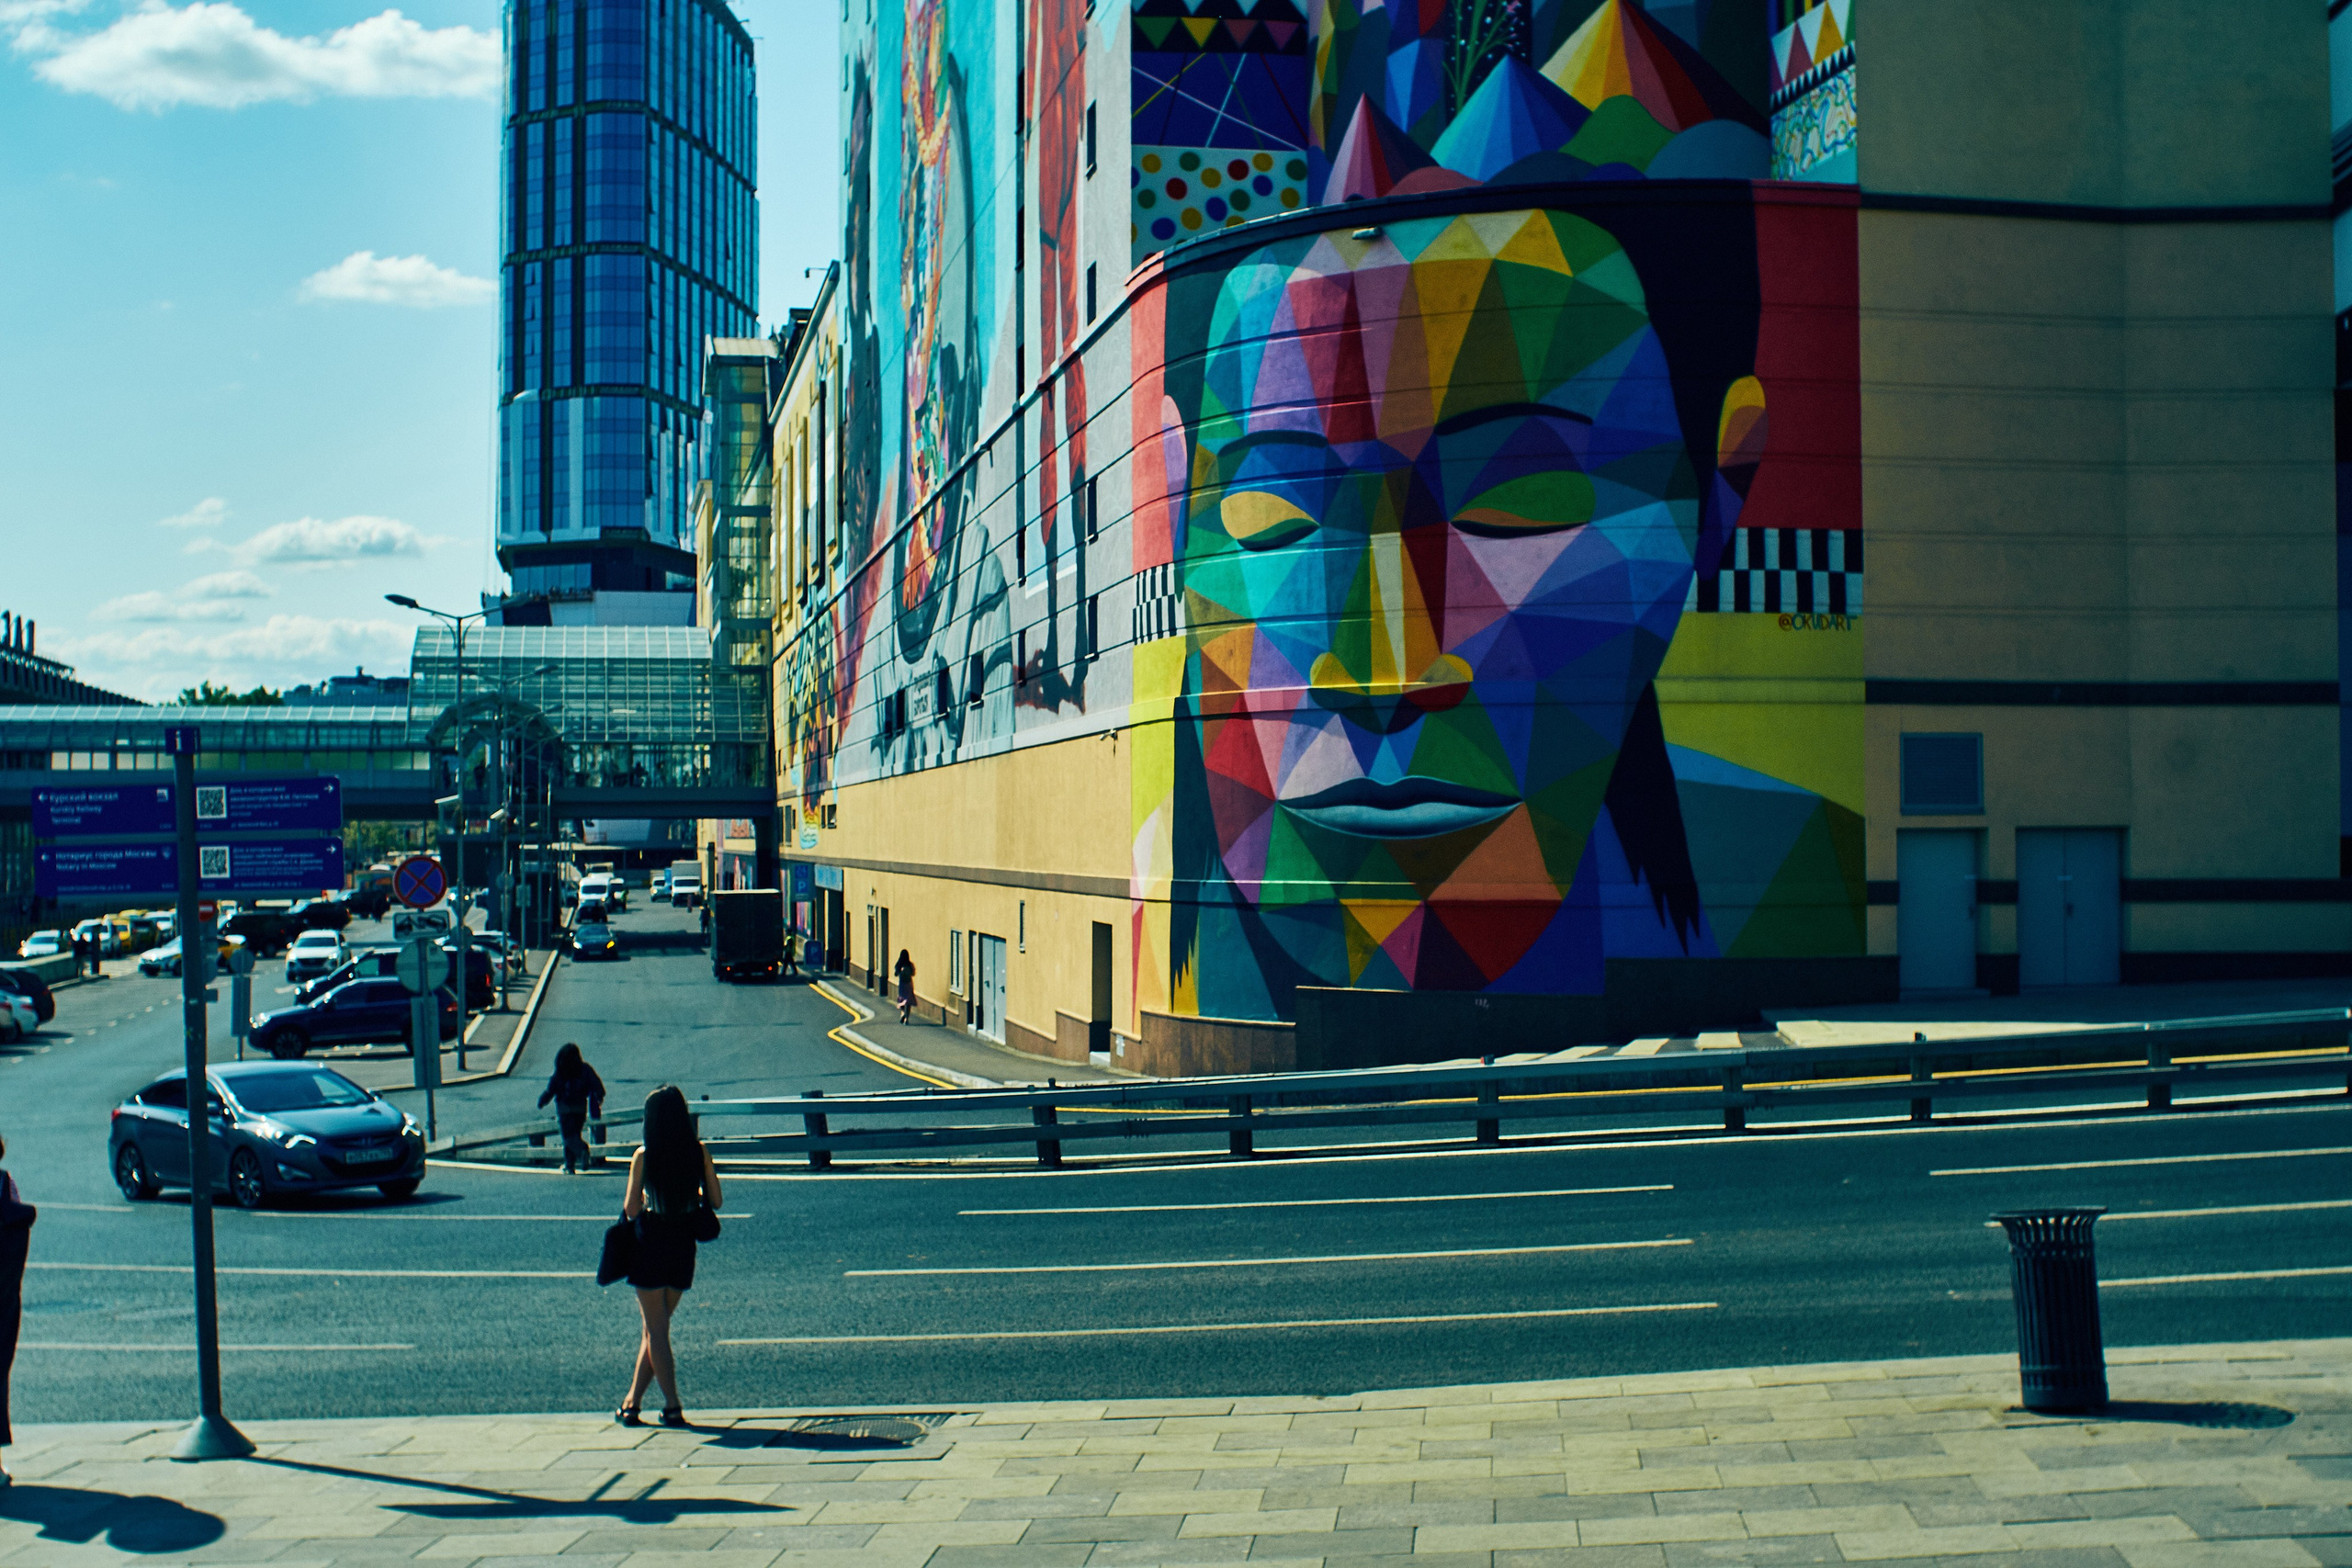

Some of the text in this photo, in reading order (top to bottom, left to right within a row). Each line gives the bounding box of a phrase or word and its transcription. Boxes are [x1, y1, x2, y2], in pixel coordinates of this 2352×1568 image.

[1778, 613, 1858, 631] @OKUDART
[50, 791, 119, 805] Курский вокзал
[52, 816, 82, 825] Terminal
[56, 849, 157, 862] Нотариус города Москвы
[56, 862, 80, 873] Notary
[89, 862, 117, 871] Moscow
[798, 880, 807, 892] P
